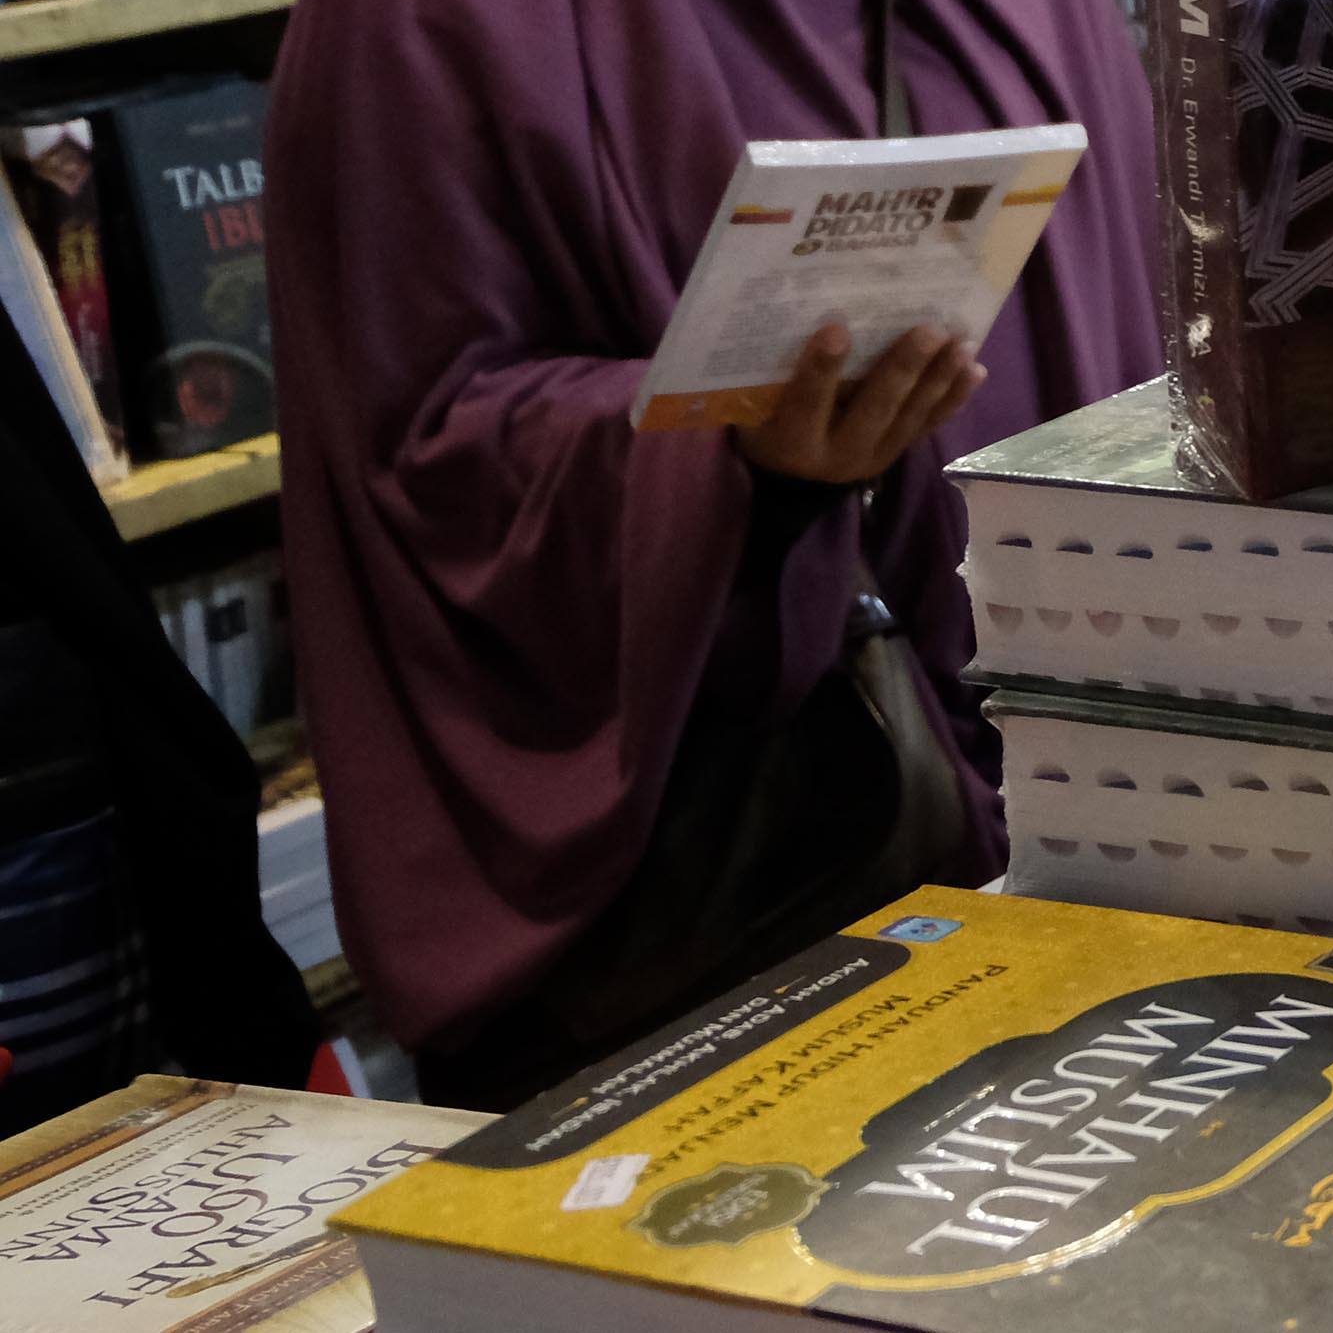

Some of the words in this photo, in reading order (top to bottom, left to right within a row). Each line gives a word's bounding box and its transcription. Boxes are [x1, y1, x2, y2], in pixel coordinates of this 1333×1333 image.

[1180, 56, 1199, 89] Dr.
[162, 158, 265, 211] TALB
[1183, 98, 1204, 202] Erwandi
[803, 210, 938, 239] PIDATO
[813, 185, 945, 216] MAHIR
[1192, 209, 1209, 304] Tmizi,
[730, 996, 771, 1021] DAN
[788, 993, 916, 1063] MUSLIM
[893, 962, 1010, 1033] PANDUAN
[662, 1061, 798, 1135] KAFFAH
[783, 1032, 894, 1098] HIDUP
[855, 1001, 1216, 1203] MUSLIM
[24, 1152, 300, 1263] ULAMA
[83, 1138, 448, 1311] BIOGRAFI
[151, 1187, 268, 1238] 60
